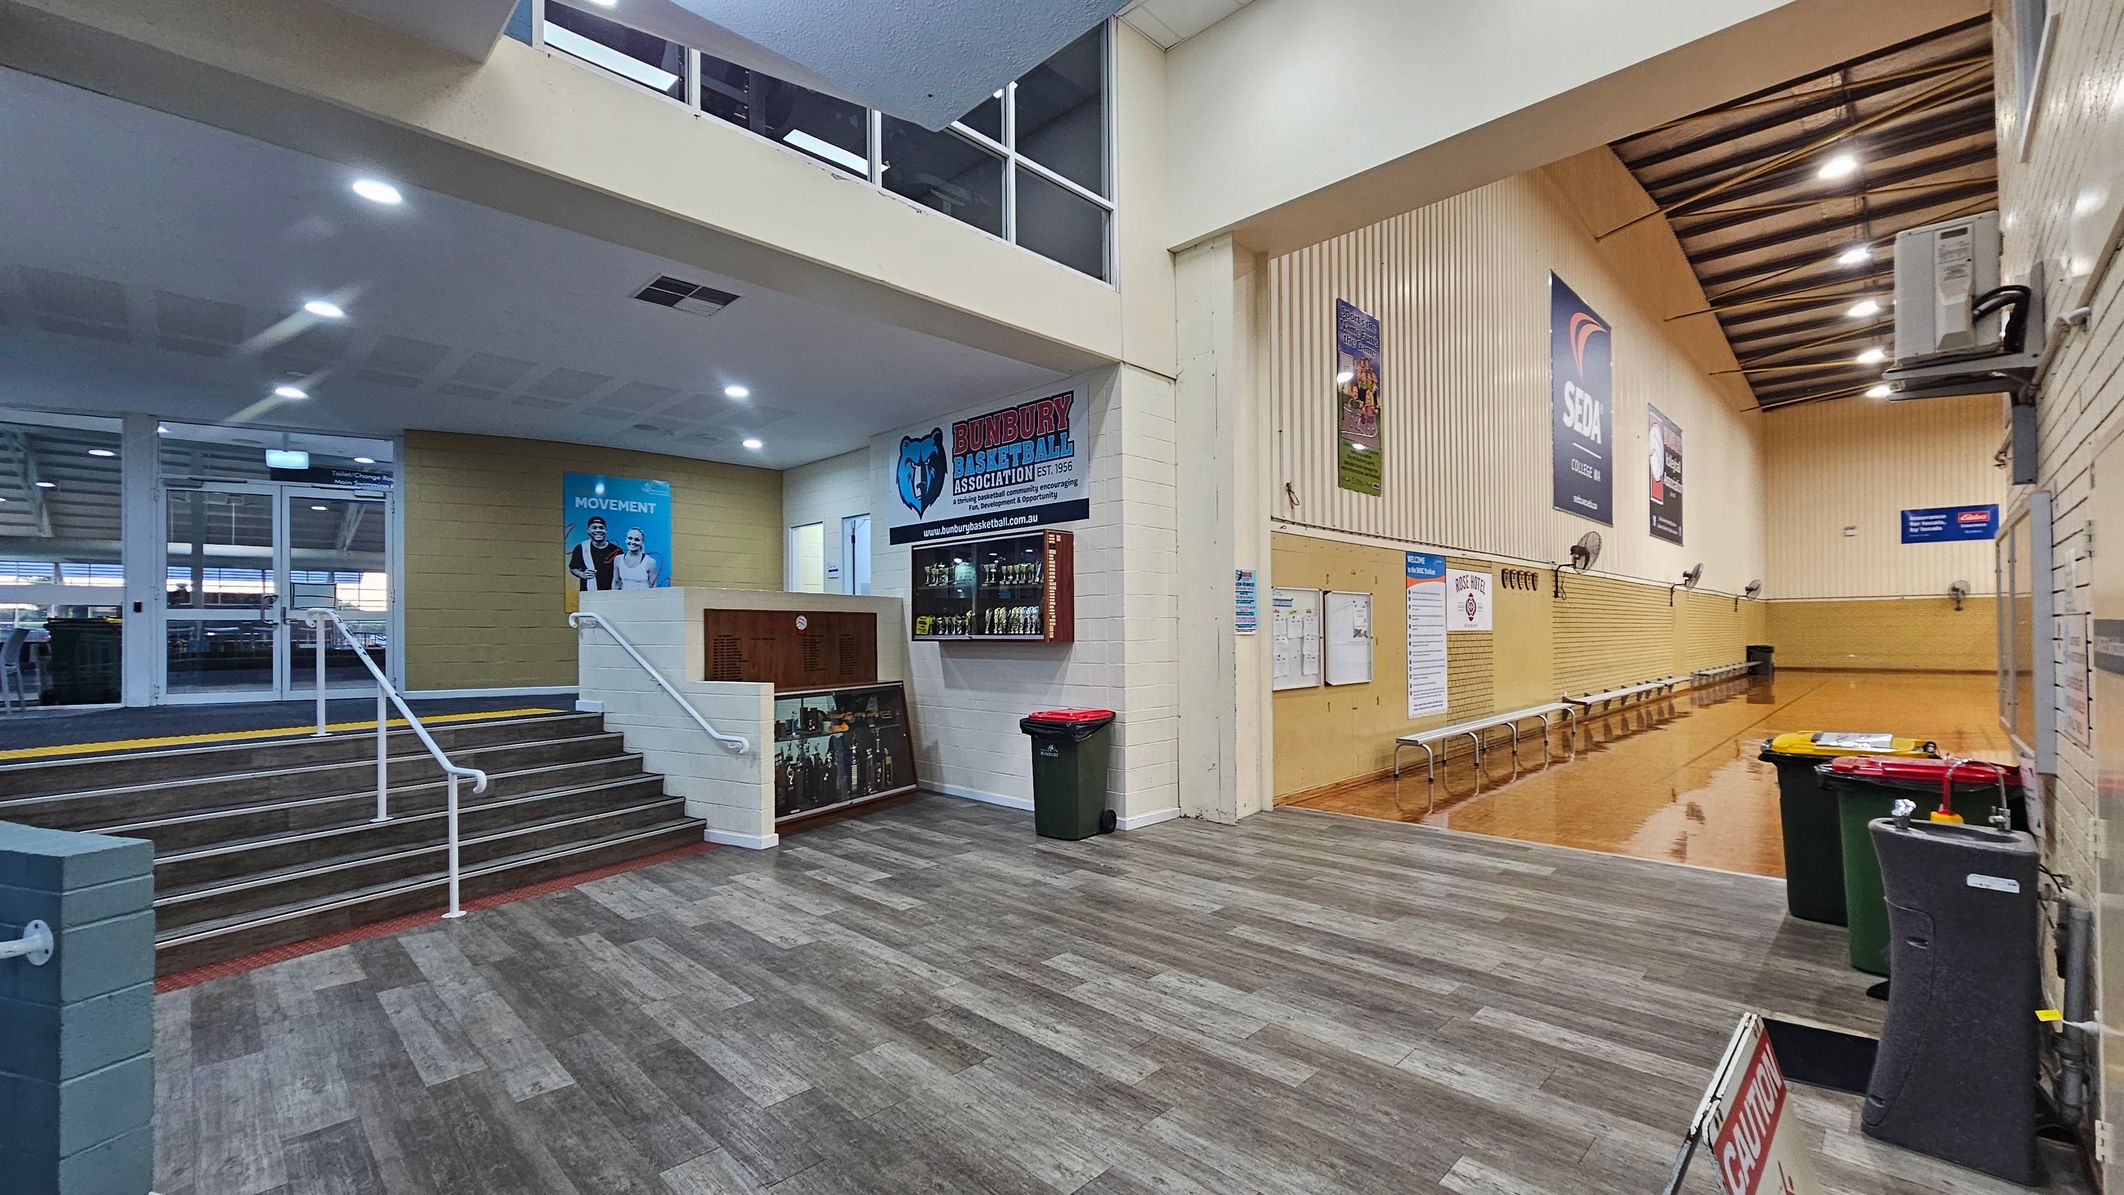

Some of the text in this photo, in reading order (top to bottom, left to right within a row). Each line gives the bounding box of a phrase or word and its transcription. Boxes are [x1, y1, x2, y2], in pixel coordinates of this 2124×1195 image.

[1356, 339, 1377, 358] Game
[953, 394, 1073, 456] BUNBURY
[1563, 381, 1601, 444] SEDA
[953, 432, 1073, 479] BASKETBALL
[954, 461, 1073, 494] ASSOCIATION EST. 1956
[1571, 458, 1593, 479] COLLEGE
[957, 495, 977, 506] thriving
[977, 489, 1005, 501] basketball
[1006, 484, 1039, 497] community
[1039, 477, 1078, 491] encouraging
[980, 497, 1016, 510] Development
[1021, 491, 1058, 504] Opportunity
[575, 496, 657, 514] MOVEMENT
[923, 513, 1038, 538] www.bunburybasketball.com.au
[1407, 555, 1425, 565] WELCOME
[1455, 574, 1486, 595] ROSE HOTEL
[1723, 1042, 1783, 1195] CAUTION
